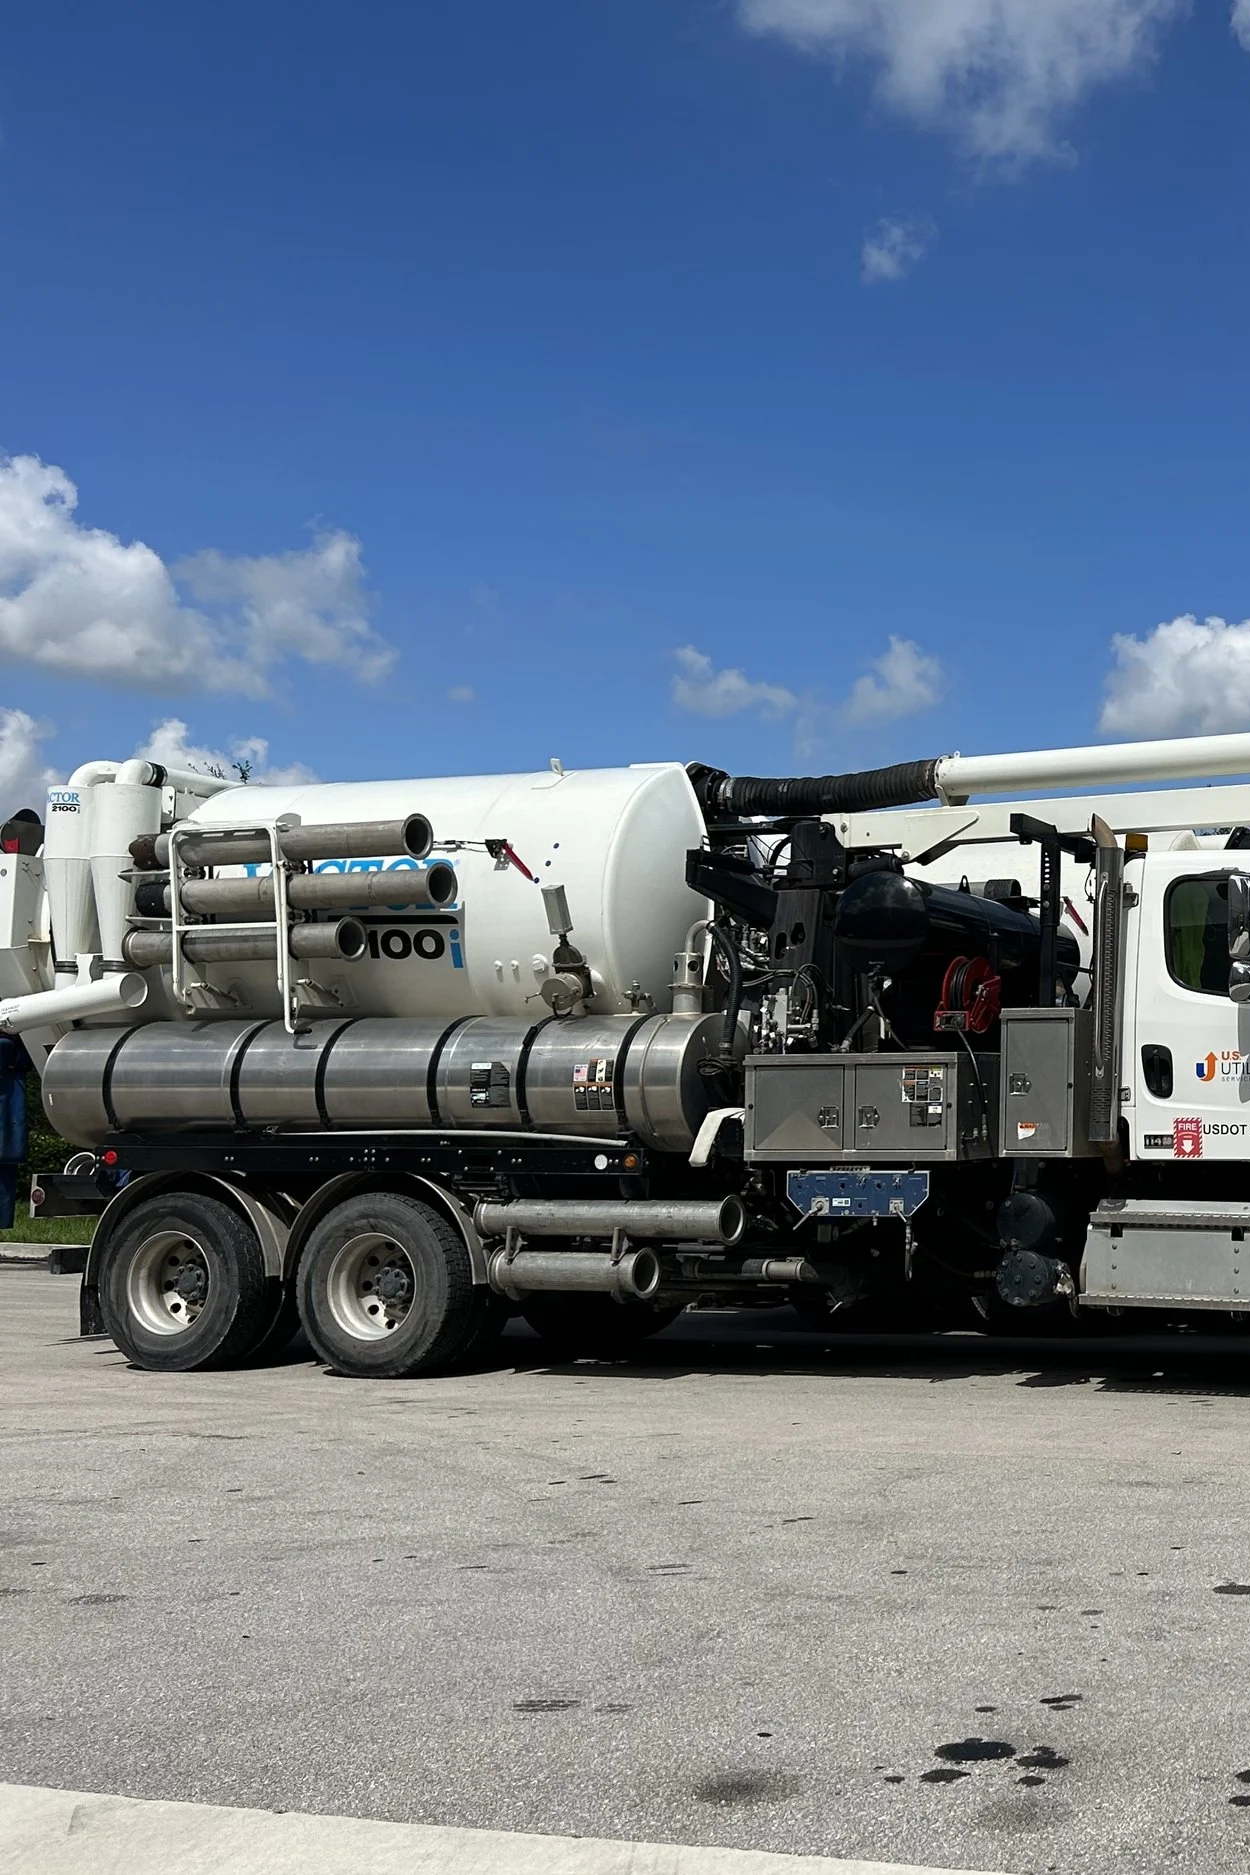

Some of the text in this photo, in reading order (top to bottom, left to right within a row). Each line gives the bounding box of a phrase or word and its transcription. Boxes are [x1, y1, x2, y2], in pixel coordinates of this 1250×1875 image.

[48, 792, 80, 803] CTOR
[1221, 1051, 1241, 1060] U.S.
[1178, 1123, 1197, 1131] FIRE
[1203, 1124, 1248, 1135] USDOT
